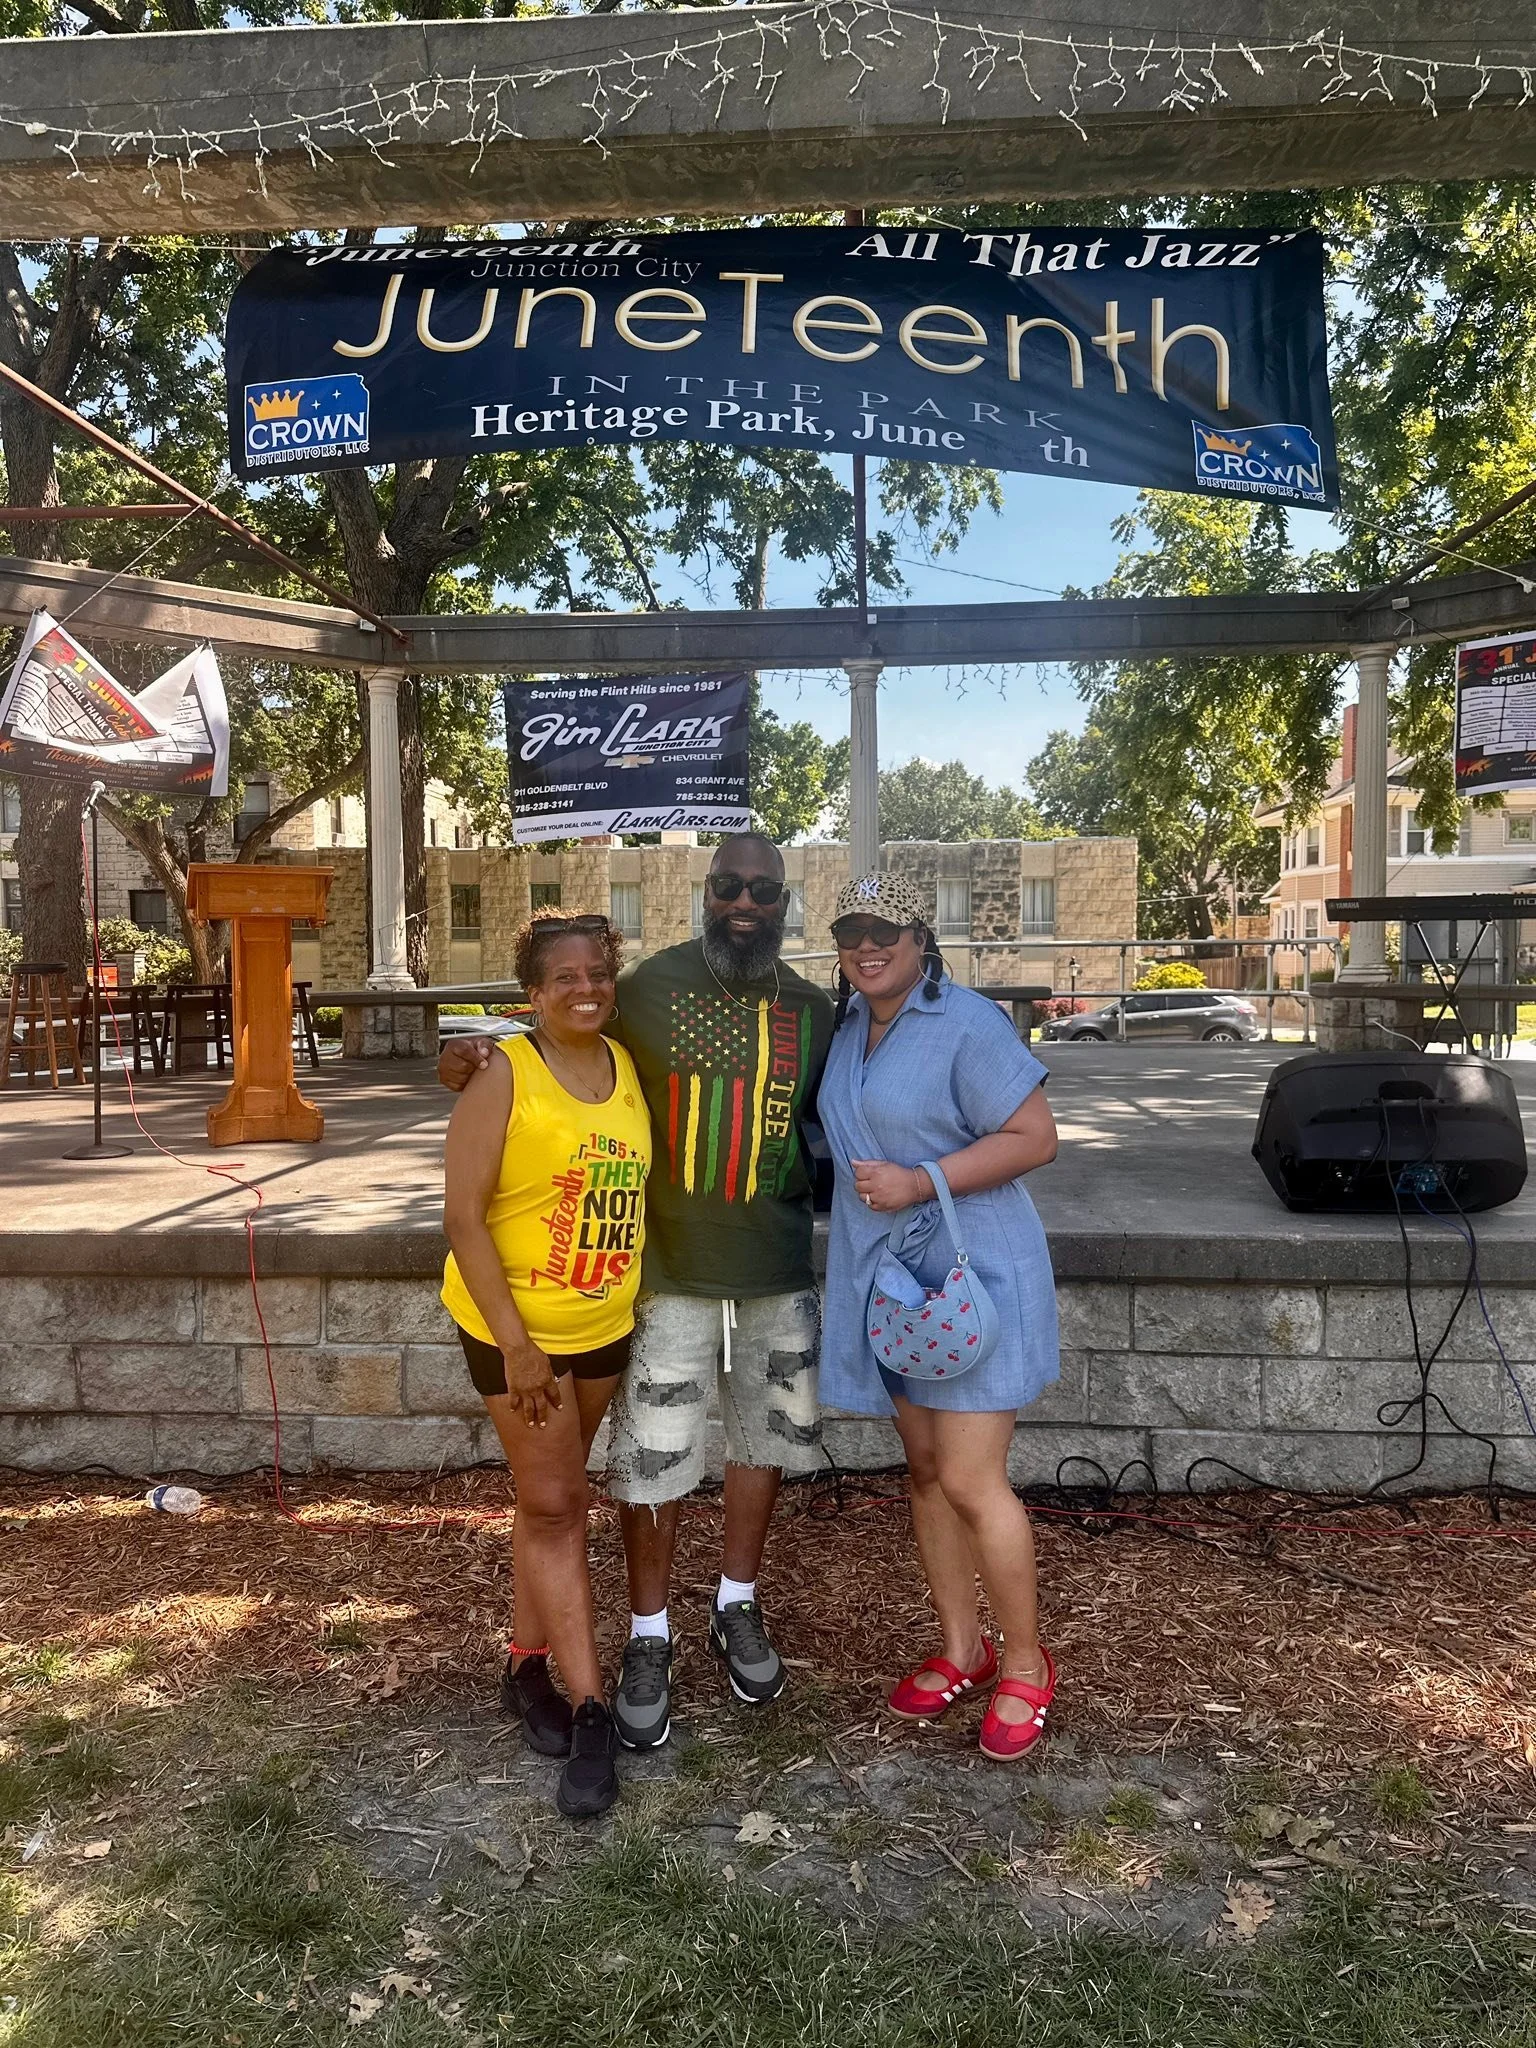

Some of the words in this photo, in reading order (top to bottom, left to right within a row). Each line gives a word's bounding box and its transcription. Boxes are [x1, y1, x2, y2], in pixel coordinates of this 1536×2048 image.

[845, 232, 937, 261] All
[961, 233, 1119, 277] That
[470, 258, 619, 278] Junction
[635, 257, 702, 284] City
[332, 272, 1230, 411] JuneTeenth
[546, 374, 631, 397] IN
[665, 376, 824, 404] THE
[858, 391, 1069, 432] PARK
[248, 411, 365, 450] CROWN
[471, 399, 689, 438] Heritage
[706, 400, 836, 443] Park,
[852, 413, 966, 451] June
[1040, 436, 1090, 468] th
[246, 445, 343, 468] DISTRIBUTORS,
[345, 441, 370, 455] LLC
[1200, 451, 1320, 489] CROWN
[1196, 477, 1300, 500] DISTRIBUTORS,
[1302, 491, 1326, 503] LLC
[1491, 671, 1536, 685] SPECIAL
[1493, 662, 1520, 673] ANNUAL
[55, 667, 85, 702] SPECIAL
[83, 701, 108, 730] THANK
[531, 687, 576, 700] Serving
[578, 687, 598, 698] the
[601, 684, 628, 697] Flint
[630, 683, 657, 695] Hills
[659, 682, 690, 694] since
[693, 680, 722, 691] 1981
[520, 713, 601, 761] Jim
[633, 740, 684, 751] JUNCTION
[685, 739, 711, 748] CITY
[44, 747, 84, 767] Thank
[662, 753, 723, 763] CHEVROLET
[514, 788, 526, 797] 911
[527, 783, 583, 795] GOLDENBELT
[584, 781, 608, 791] BLVD
[676, 776, 693, 785] 834
[694, 776, 725, 785] GRANT
[727, 777, 745, 786] AVE
[515, 799, 574, 813] 785-238-3141
[676, 793, 740, 802] 785-238-3142
[516, 826, 547, 834] CUSTOMIZE
[580, 820, 604, 828] ONLINE:
[759, 1001, 797, 1197] JUNETEENTH
[589, 1132, 627, 1159] 1865
[587, 1161, 646, 1188] THEY
[583, 1188, 640, 1221] NOT
[530, 1166, 586, 1291] Juneteenth
[577, 1222, 635, 1251] LIKE
[569, 1252, 631, 1291] US
